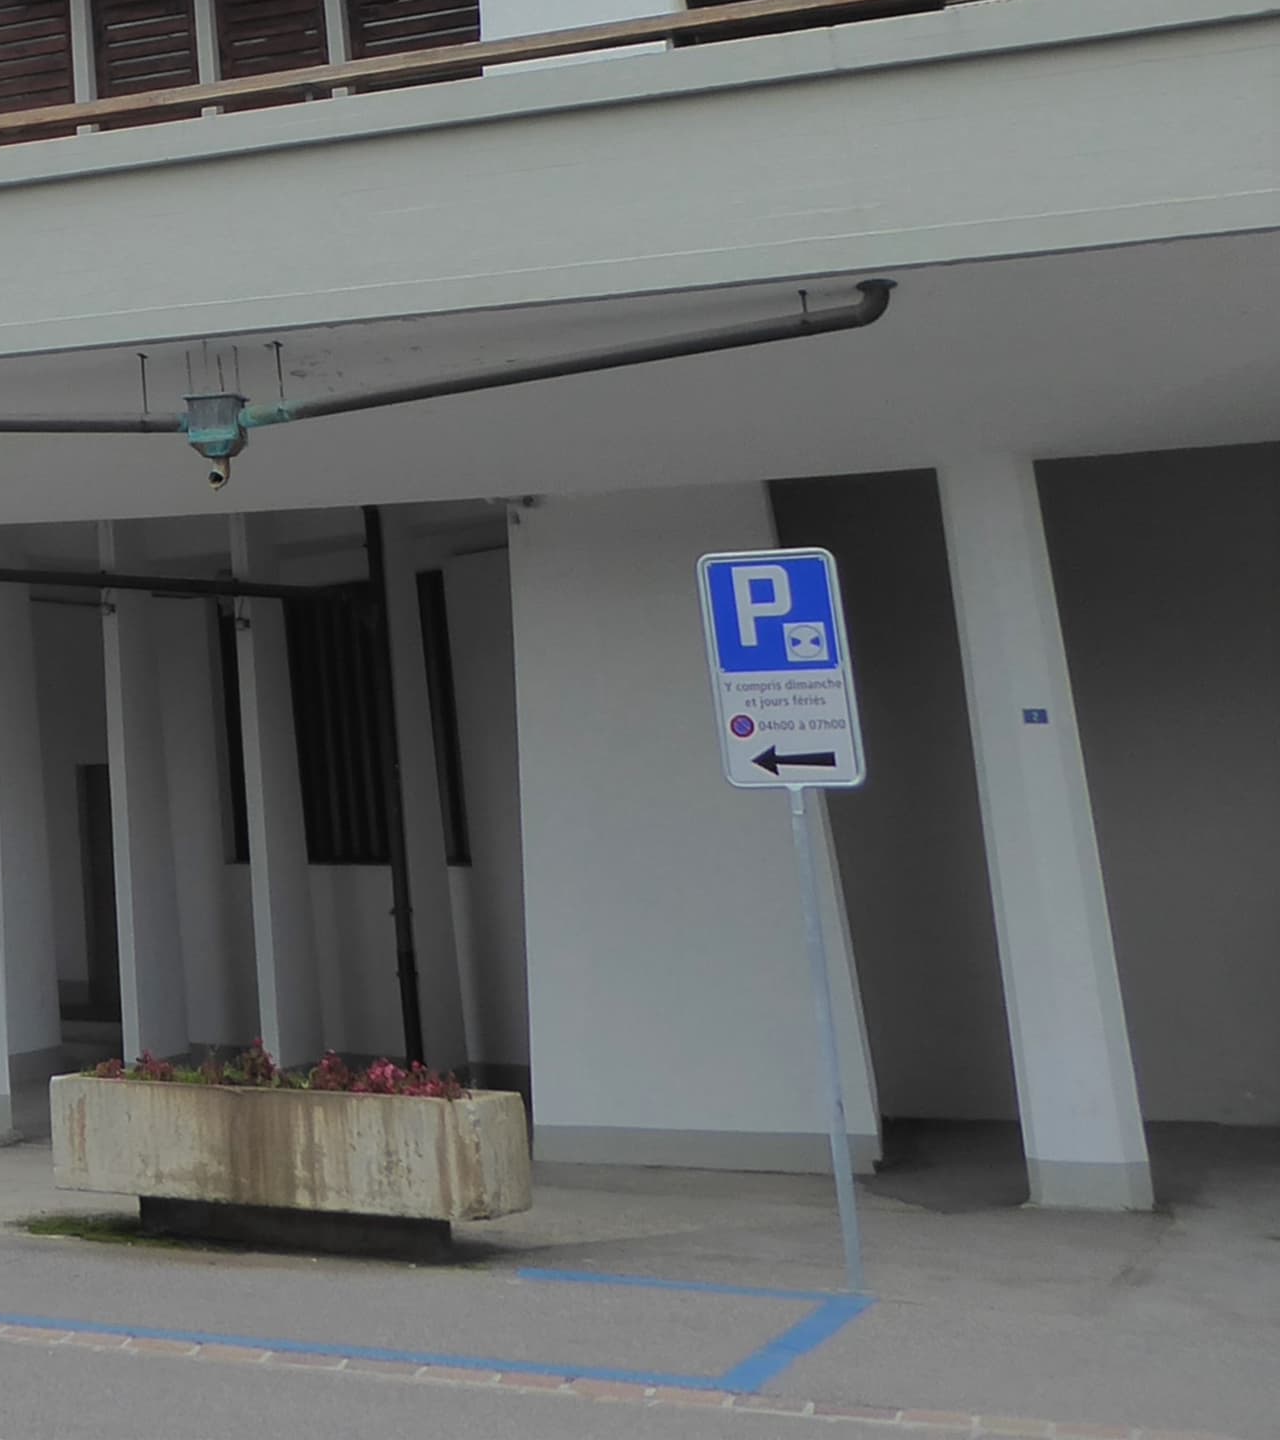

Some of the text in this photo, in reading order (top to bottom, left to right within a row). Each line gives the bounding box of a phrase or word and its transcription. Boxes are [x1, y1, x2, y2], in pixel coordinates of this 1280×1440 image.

[731, 565, 792, 647] P
[736, 680, 781, 693] compris
[785, 678, 842, 690] dimanche
[745, 698, 757, 707] et
[760, 696, 789, 709] jours
[758, 720, 795, 731] 04h00
[808, 718, 846, 730] 07h00
